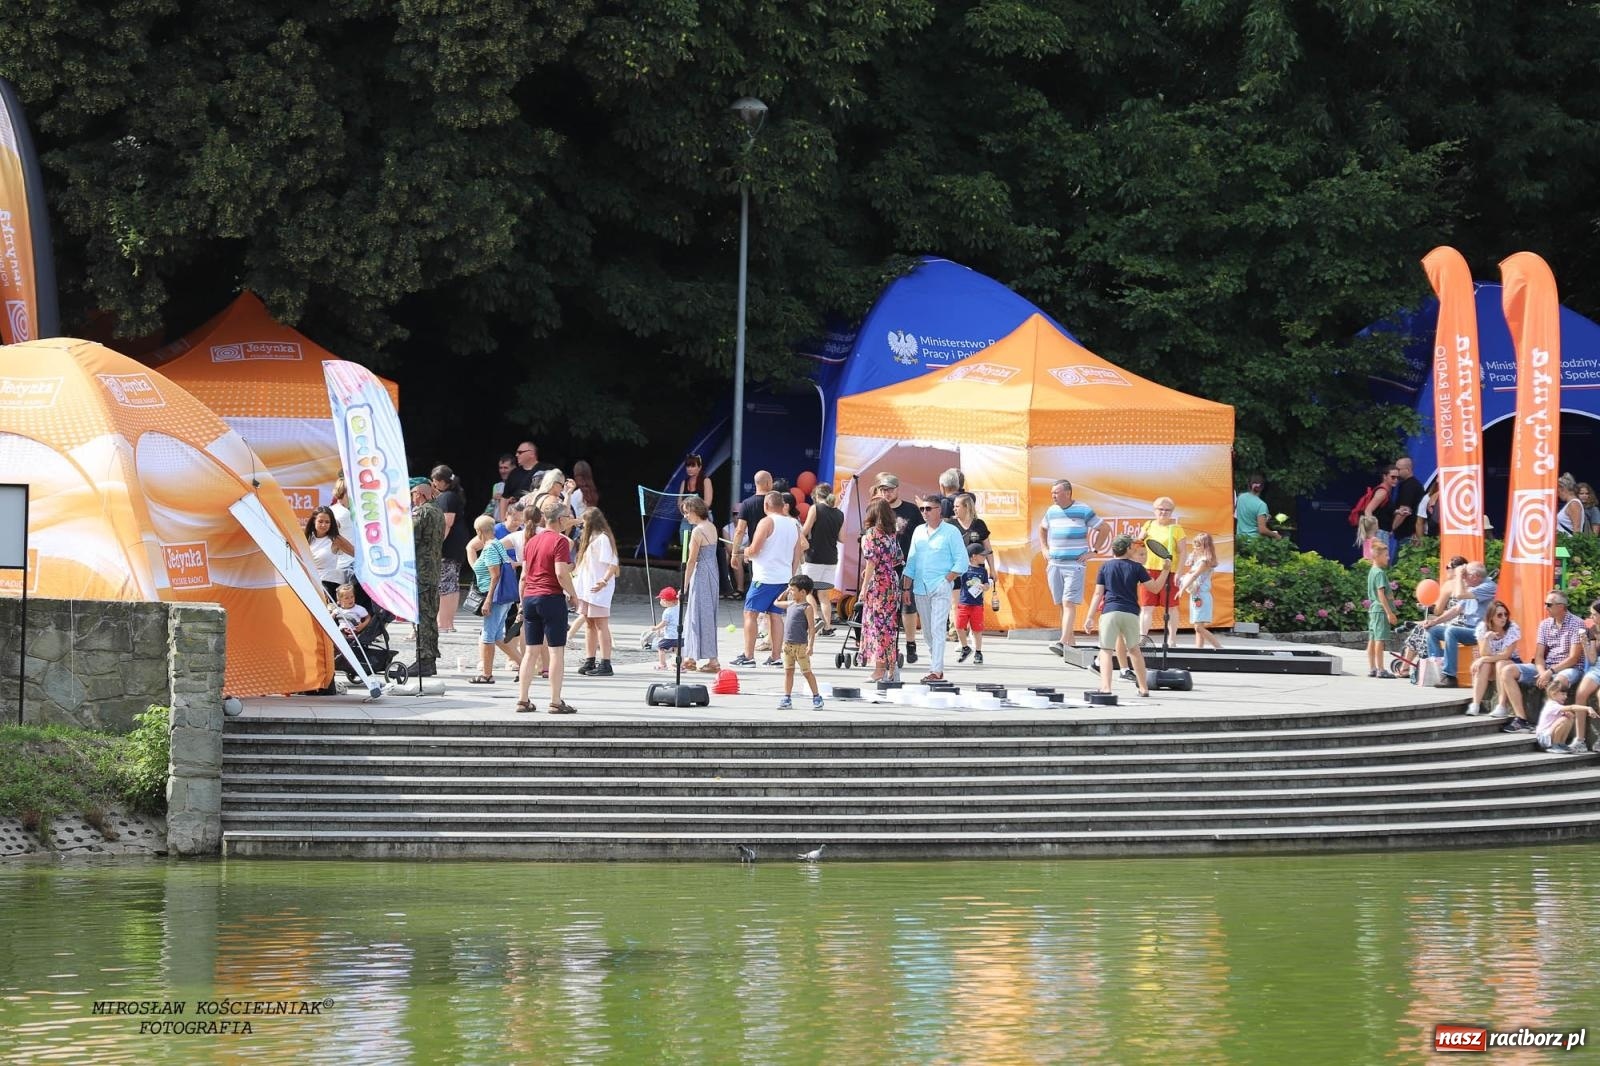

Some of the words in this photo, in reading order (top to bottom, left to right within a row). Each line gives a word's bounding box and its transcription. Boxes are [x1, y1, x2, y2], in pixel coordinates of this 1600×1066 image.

[920, 335, 985, 349] Ministerstwo
[246, 343, 296, 354] Jedynka
[922, 348, 949, 360] Pracy
[951, 350, 956, 360] i
[1489, 372, 1517, 383] Pracy
[166, 548, 204, 574] Jedynka
